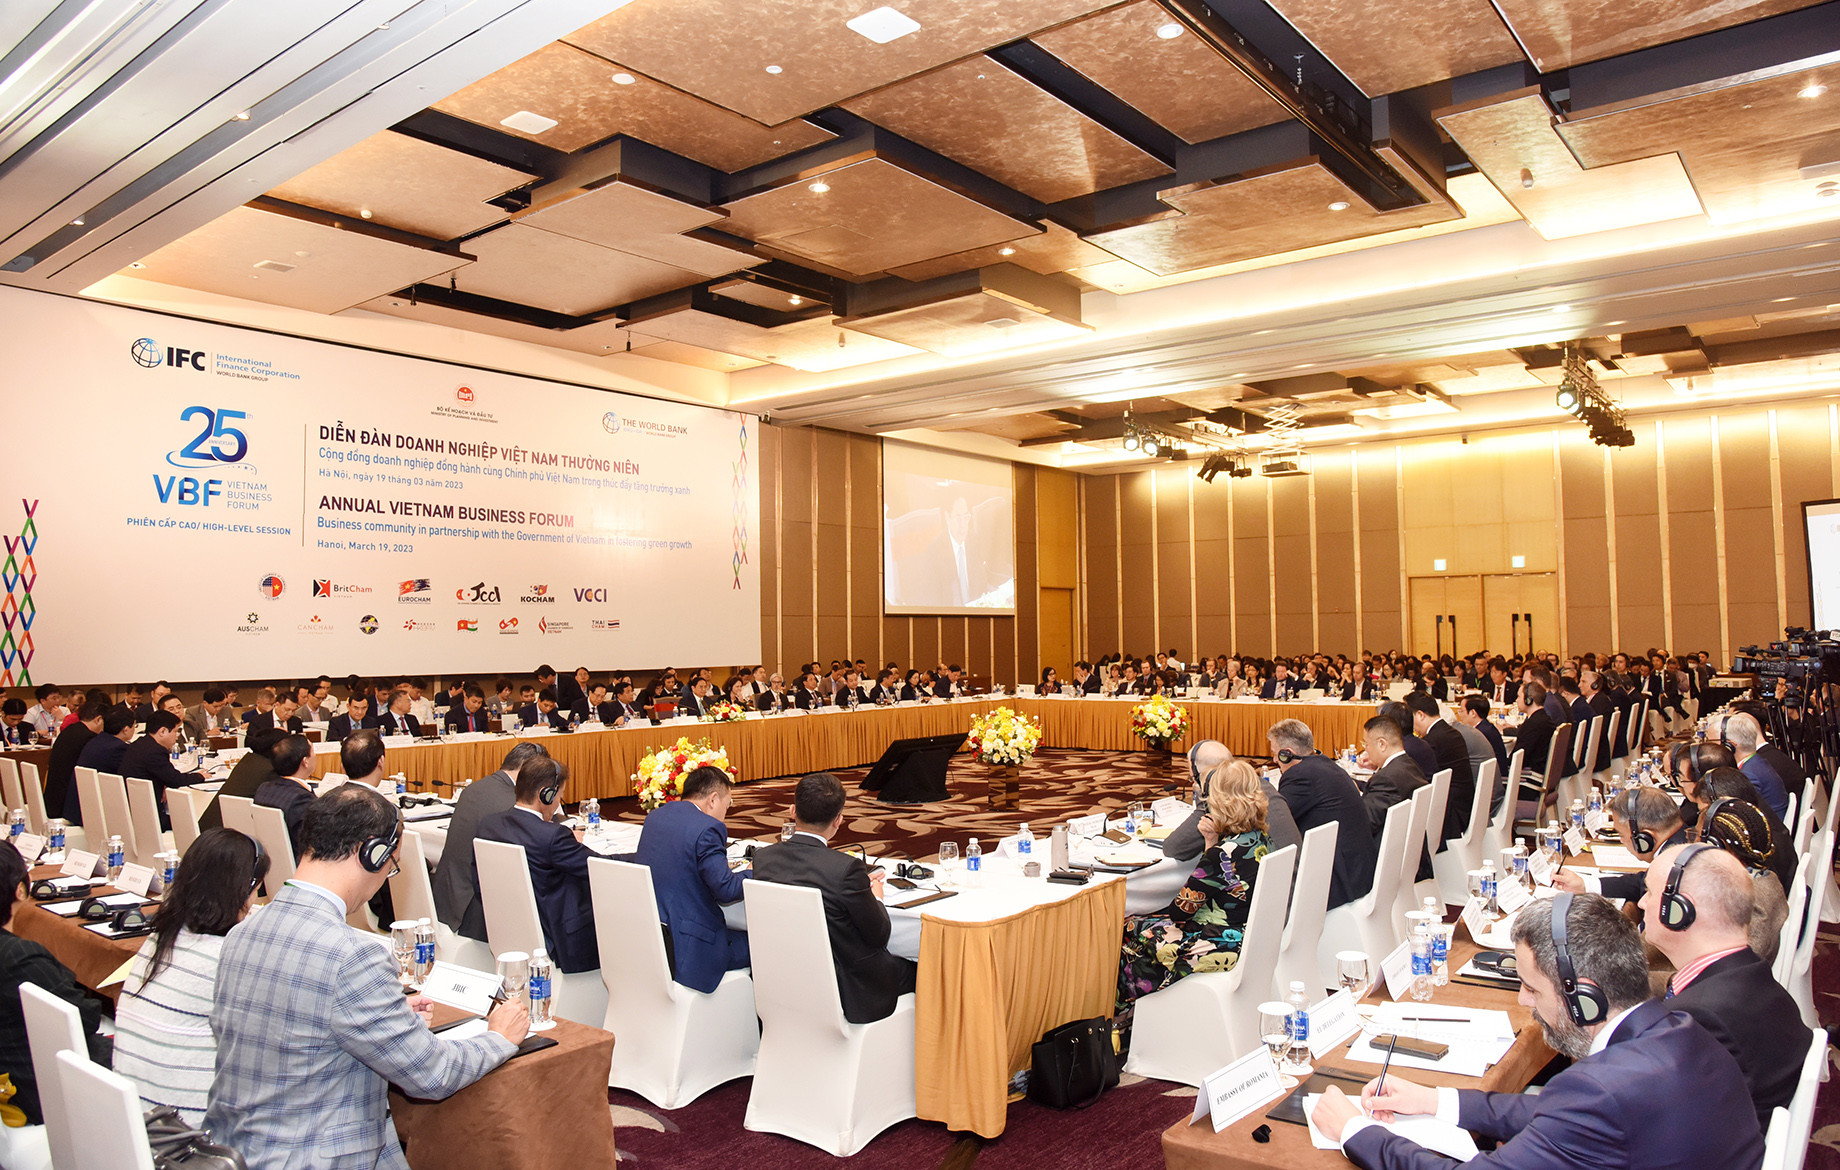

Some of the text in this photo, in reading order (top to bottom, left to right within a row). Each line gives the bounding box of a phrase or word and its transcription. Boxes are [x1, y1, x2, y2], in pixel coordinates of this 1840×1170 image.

[166, 346, 206, 371] IFC
[216, 354, 272, 368] International
[216, 362, 300, 380] Finance Corporation
[622, 418, 688, 434] THE WORLD BANK
[320, 420, 640, 476] DIỄN ĐÀN DOANH NGHIỆP VIỆT NAM THƯỜNG NIÊN
[319, 446, 344, 462] Cộng
[373, 454, 402, 466] doanh
[404, 458, 434, 472] nghiệp
[460, 462, 480, 474] hành
[482, 464, 502, 478] cùng
[504, 467, 528, 479] Chính
[546, 471, 560, 484] Việt
[562, 474, 580, 484] Nam
[582, 476, 601, 488] trong
[674, 486, 690, 495] xanh
[319, 468, 330, 478] Hà
[334, 470, 350, 480] Nội,
[354, 472, 374, 482] ngày
[388, 475, 412, 486] tháng
[414, 478, 424, 486] 03
[426, 478, 442, 488] năm
[444, 480, 464, 489] 2023
[152, 474, 222, 506] VBF
[227, 480, 267, 491] VIETNAM
[227, 490, 272, 502] BUSINESS
[227, 501, 259, 510] FORUM
[319, 496, 574, 528] ANNUAL VIETNAM BUSINESS FORUM
[127, 516, 291, 536] PHIÊN CẤP CAO/ HIGH-LEVEL SESSION
[318, 516, 362, 530] Business
[364, 522, 416, 536] community
[418, 524, 426, 534] in
[429, 526, 480, 540] partnership
[482, 528, 500, 539] with
[502, 530, 515, 540] the
[516, 531, 564, 543] Government
[566, 534, 574, 543] of
[576, 534, 606, 545] Vietnam
[648, 540, 668, 550] green
[669, 540, 692, 550] growth
[318, 540, 414, 553] Hanoi, March 19, 2023
[334, 584, 372, 593] BritCham
[574, 588, 606, 602] VCCI
[1216, 1071, 1268, 1104] EMBASSY OF ROMANIA
